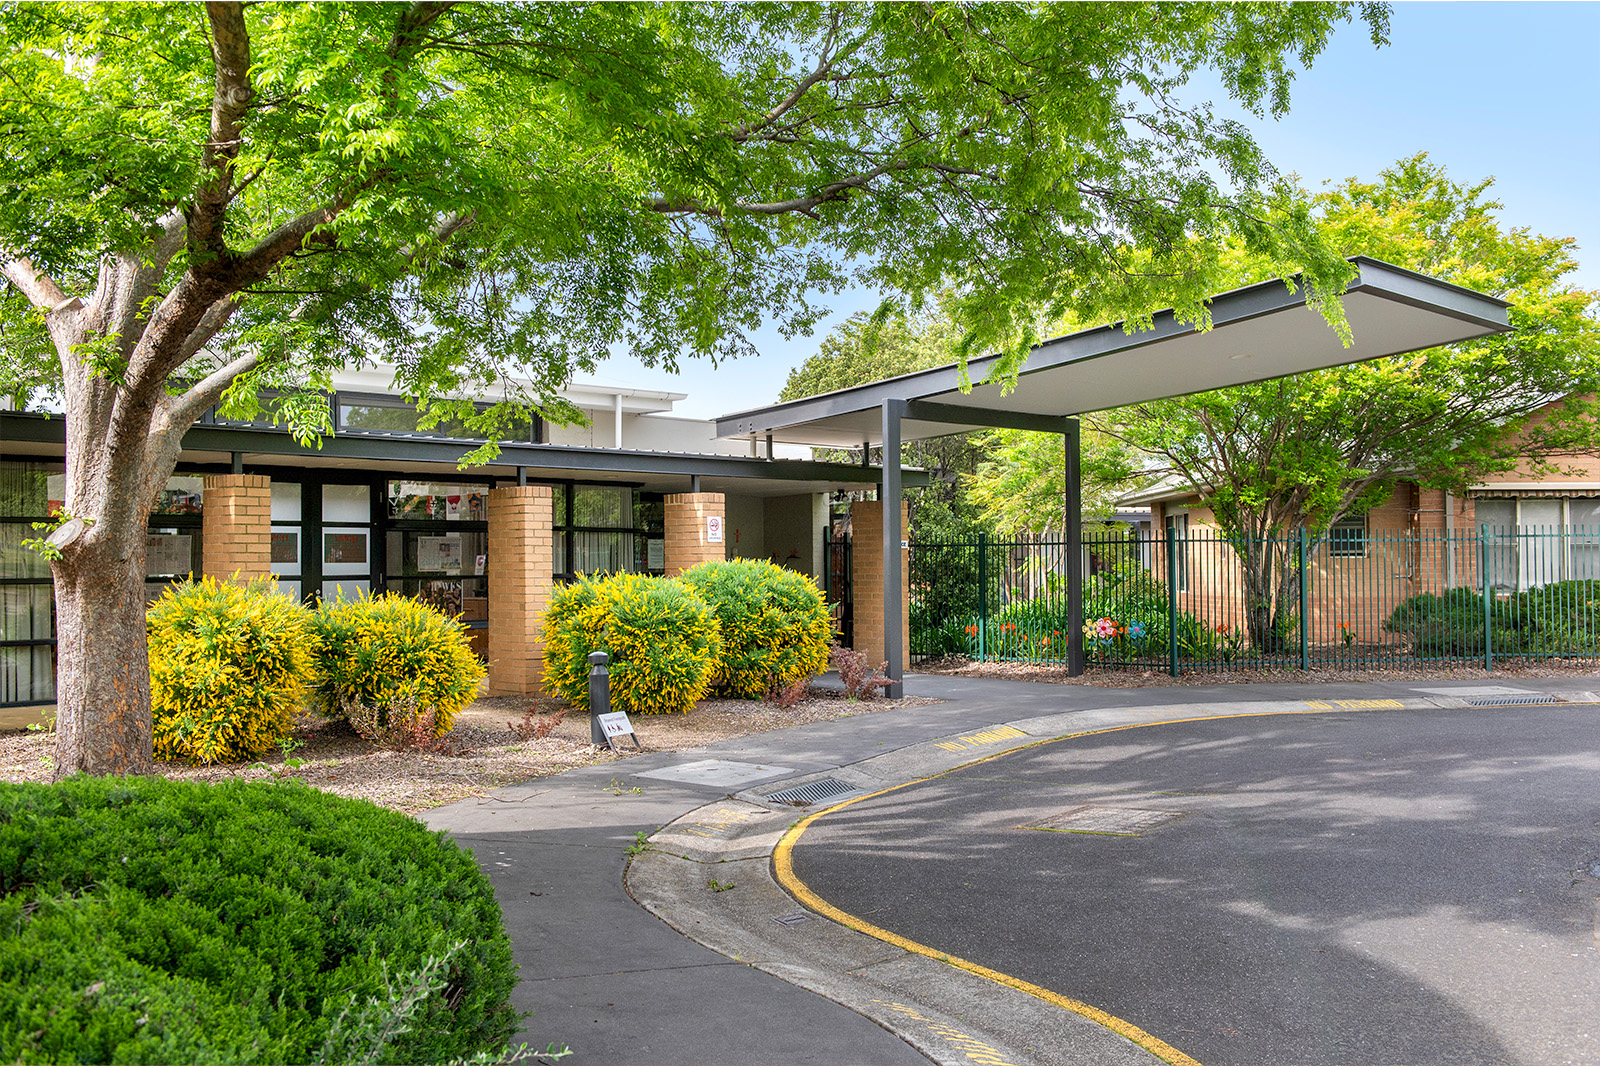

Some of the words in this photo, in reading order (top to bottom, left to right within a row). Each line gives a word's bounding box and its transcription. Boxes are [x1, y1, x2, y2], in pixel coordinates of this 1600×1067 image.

[1303, 701, 1333, 710] NO
[934, 741, 968, 752] NO
[958, 726, 1025, 747] PARKING
